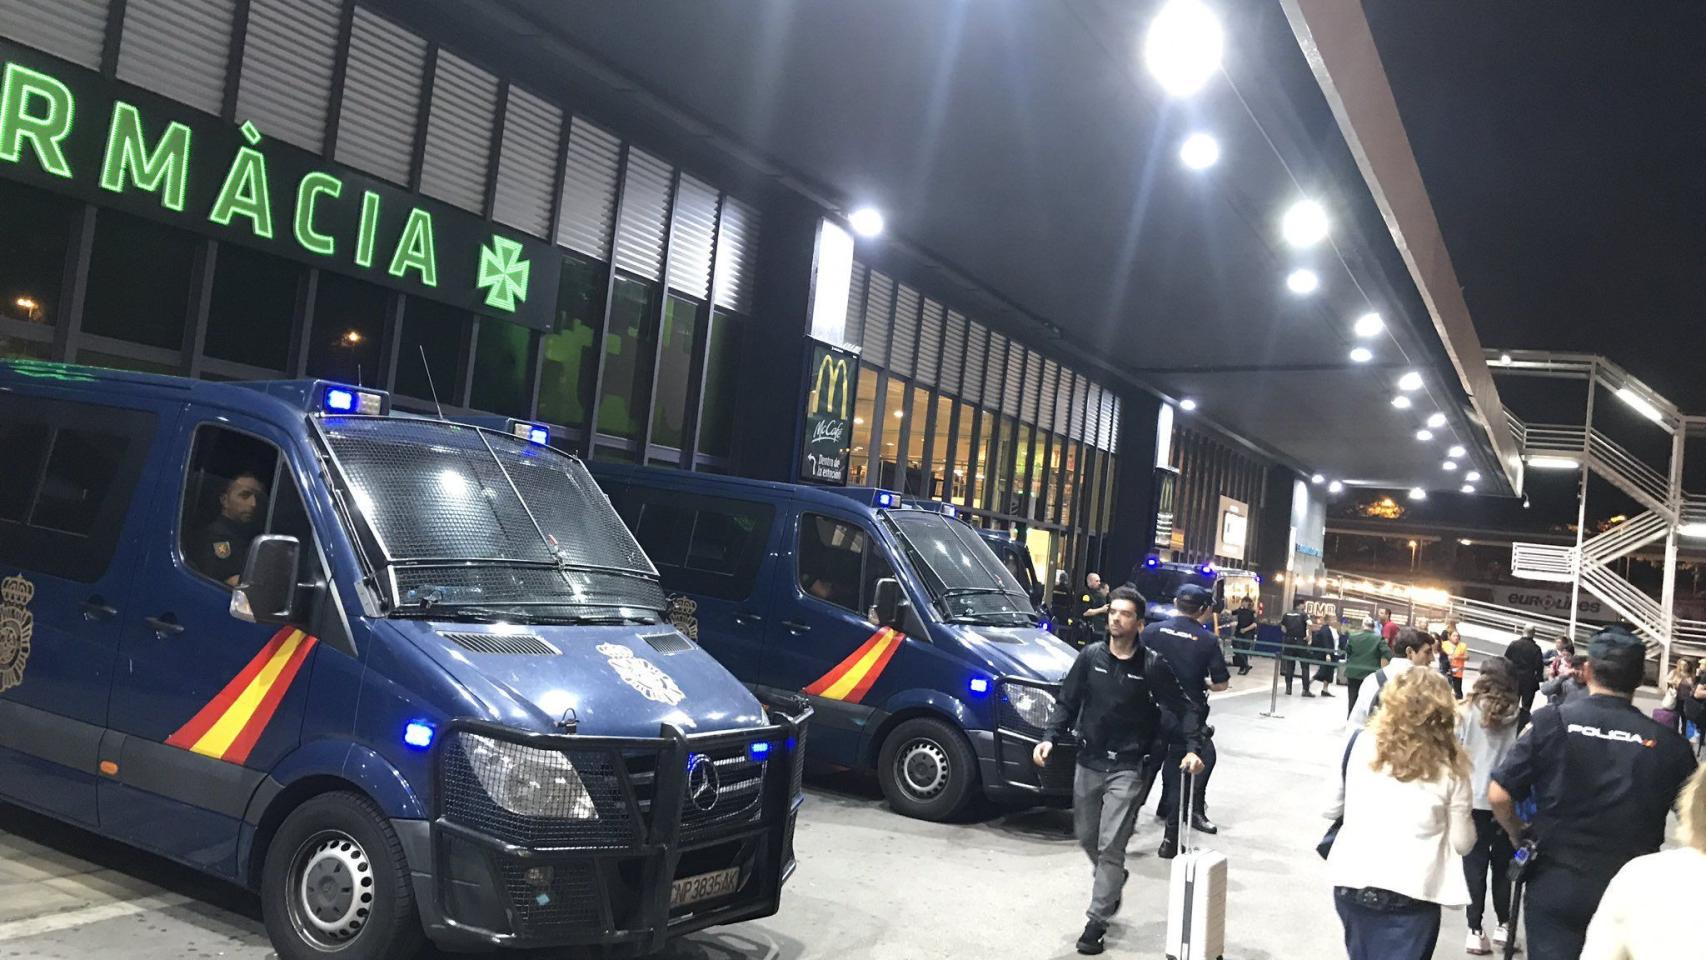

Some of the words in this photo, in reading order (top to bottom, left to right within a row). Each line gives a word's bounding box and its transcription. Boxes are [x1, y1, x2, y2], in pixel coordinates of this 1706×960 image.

[0, 61, 438, 288] RMÀCIA
[812, 419, 843, 442] McCafé
[817, 465, 823, 477] la
[818, 454, 833, 467] Dentro
[834, 457, 840, 468] de
[1567, 724, 1643, 744] POLICIA
